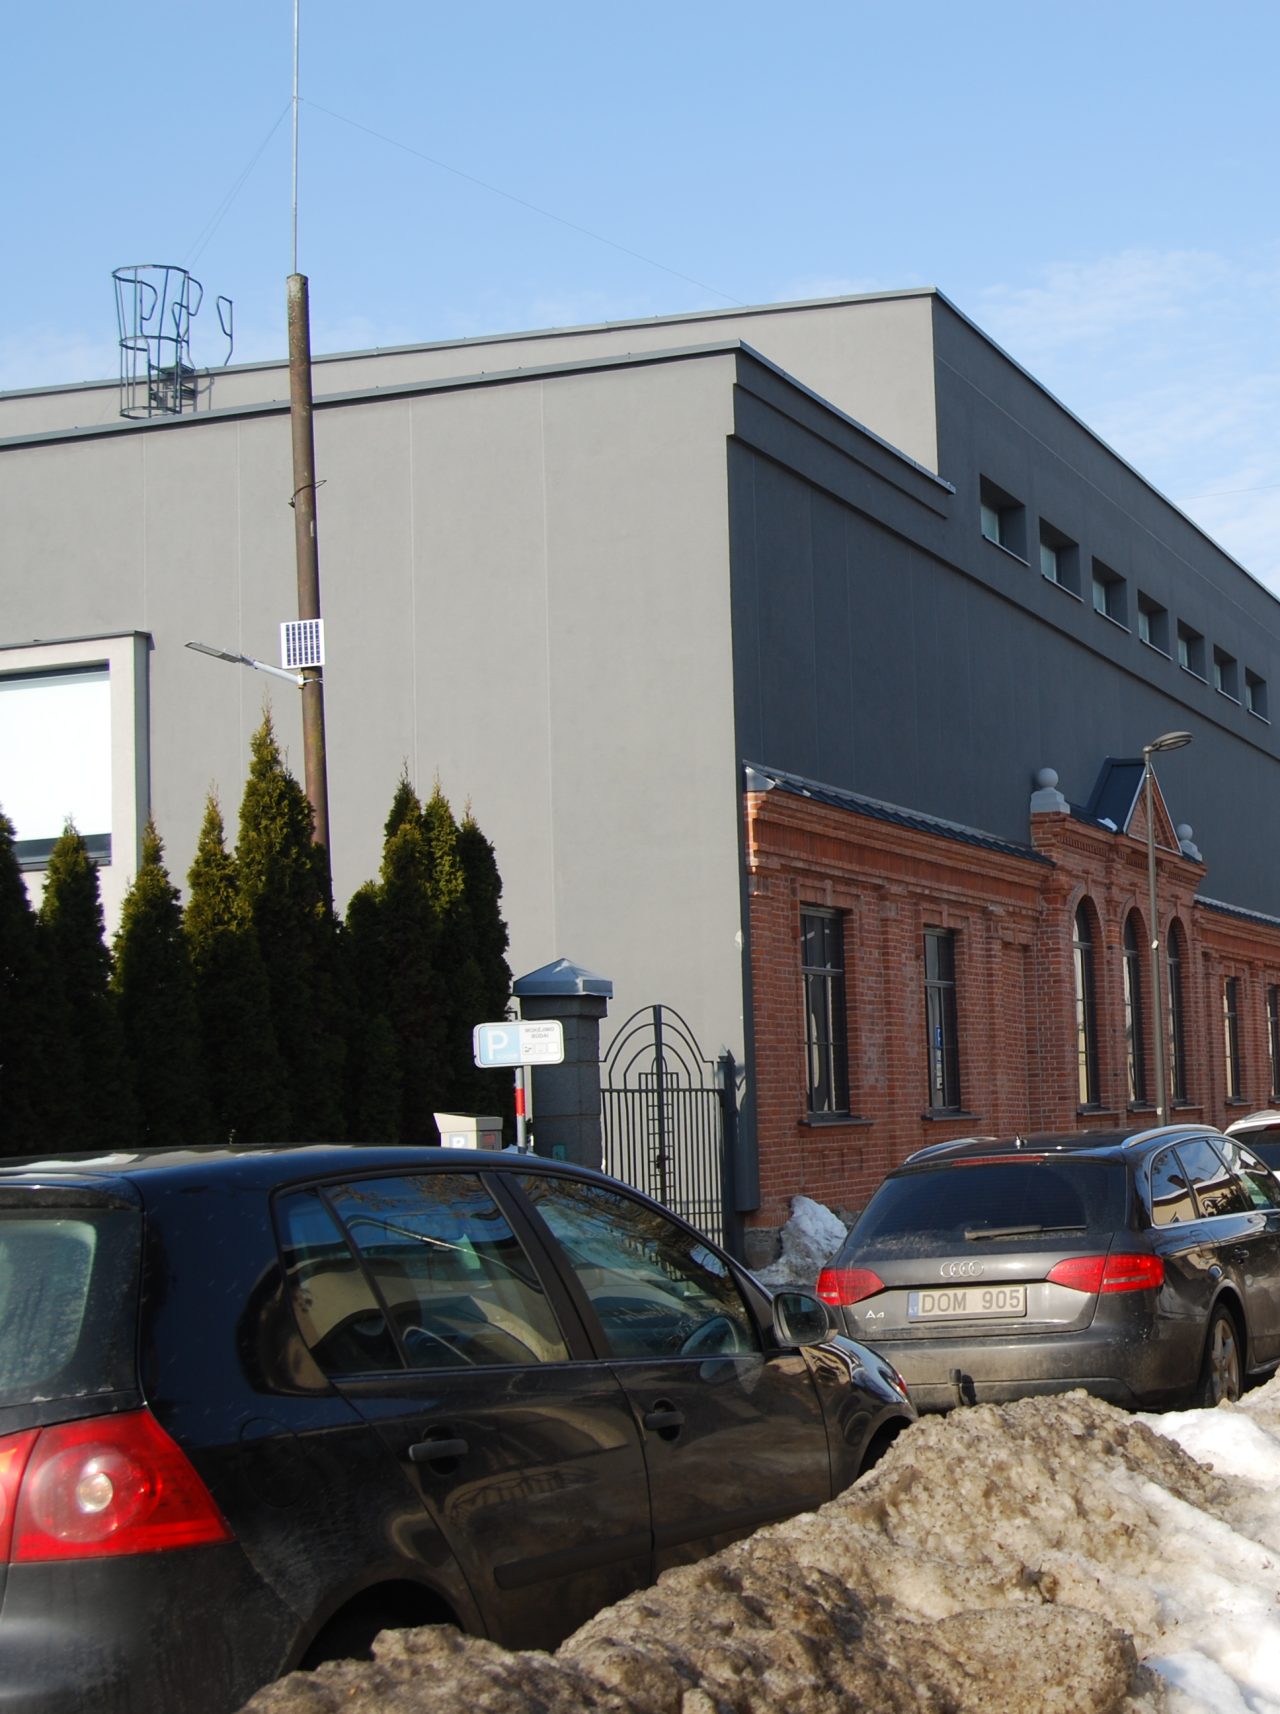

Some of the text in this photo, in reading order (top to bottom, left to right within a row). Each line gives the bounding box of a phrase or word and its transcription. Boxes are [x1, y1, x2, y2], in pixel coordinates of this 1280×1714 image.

[487, 1029, 509, 1060] P
[921, 1292, 967, 1313] DOM
[982, 1289, 1021, 1310] 905
[864, 1309, 885, 1319] A4
